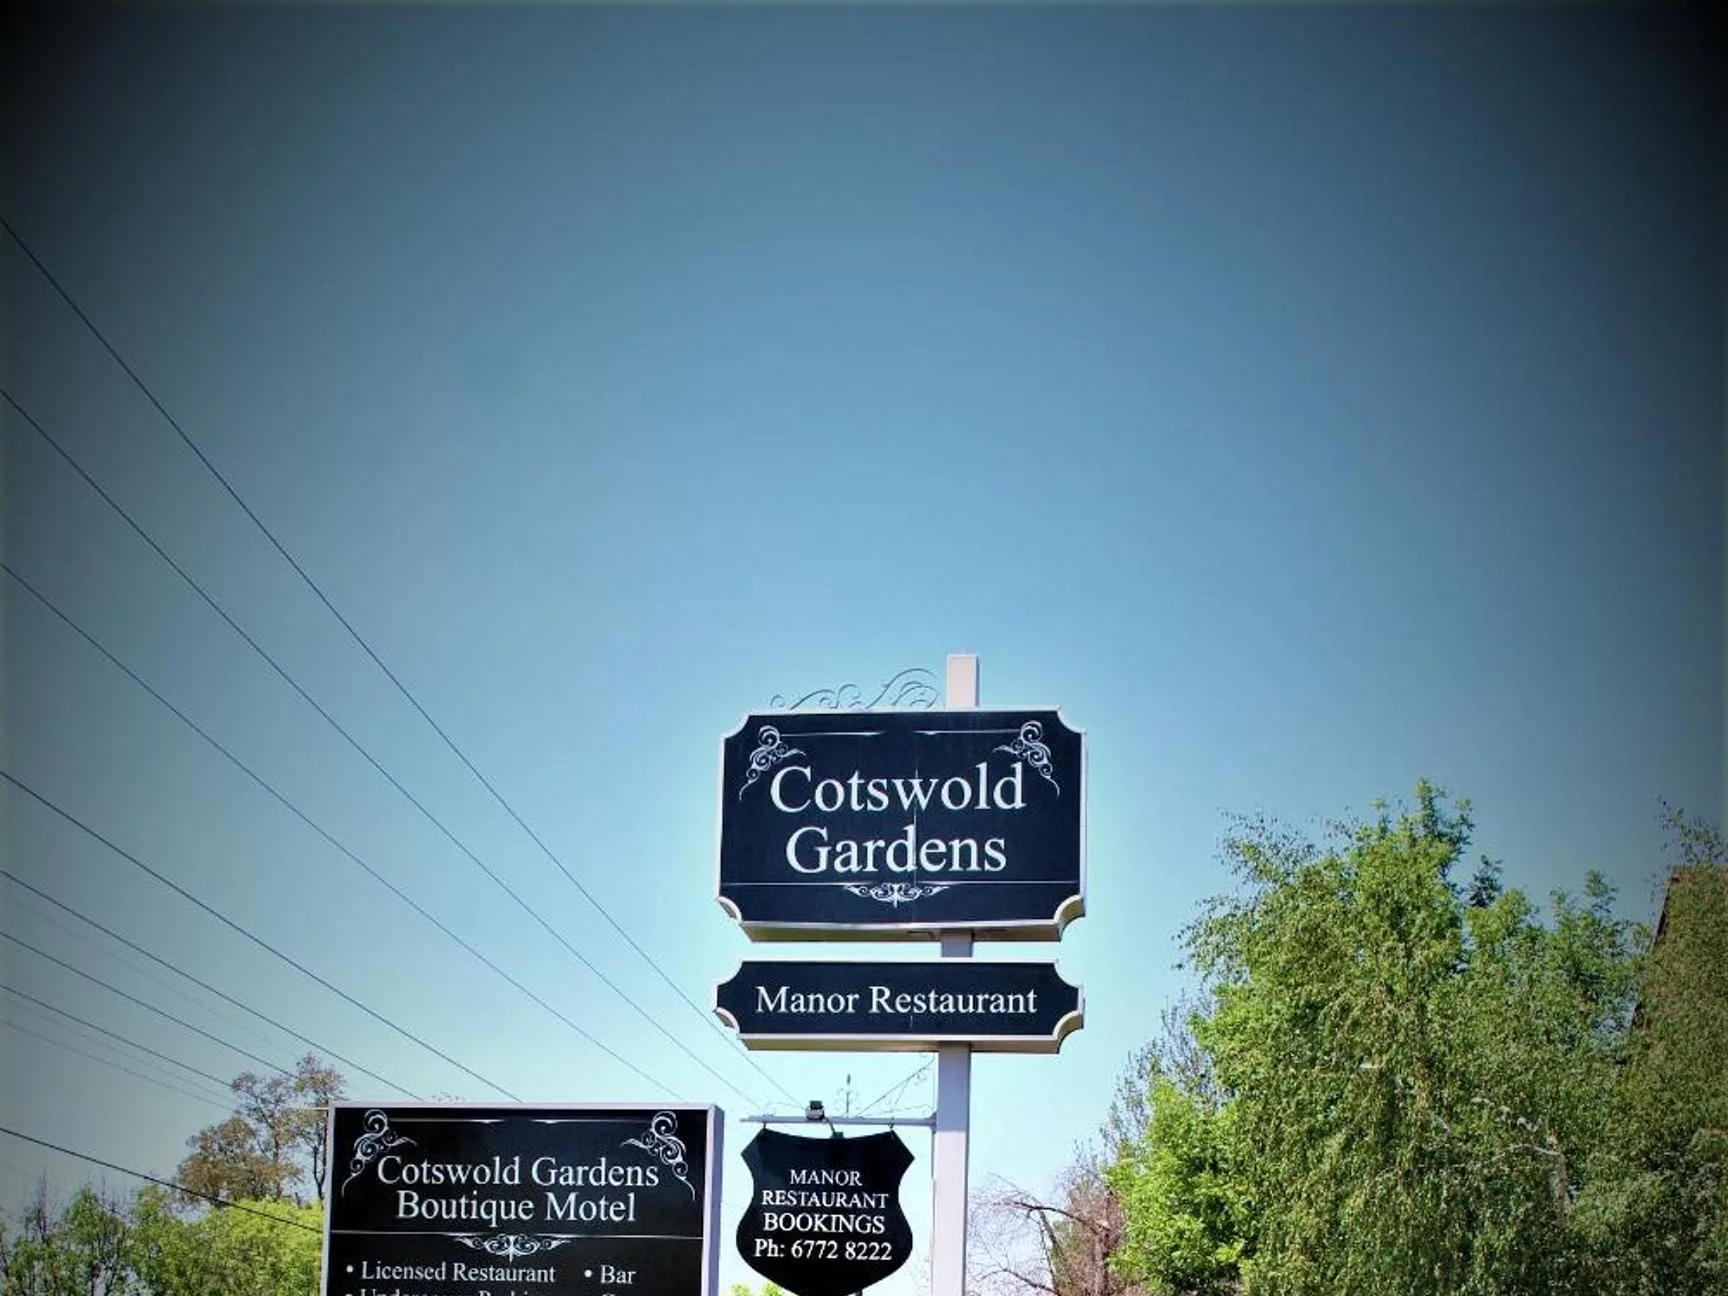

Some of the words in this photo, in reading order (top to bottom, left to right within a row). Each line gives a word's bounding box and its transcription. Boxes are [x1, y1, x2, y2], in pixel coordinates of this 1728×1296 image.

[769, 761, 1027, 813] Cotswold
[785, 824, 1007, 873] Gardens
[755, 985, 859, 1014] Manor
[868, 985, 1038, 1014] Restaurant
[377, 1156, 520, 1186] Cotswold
[531, 1157, 659, 1187] Gardens
[789, 1169, 863, 1187] MANOR
[397, 1190, 534, 1227] Boutique
[544, 1192, 636, 1222] Motel
[761, 1190, 889, 1209] RESTAURANT
[763, 1212, 885, 1234] BOOKINGS
[754, 1238, 785, 1258] Ph:
[791, 1239, 838, 1259] 6772
[844, 1242, 892, 1261] 8222
[360, 1261, 446, 1282] Licensed
[452, 1262, 556, 1283] Restaurant
[600, 1265, 636, 1285] Bar
